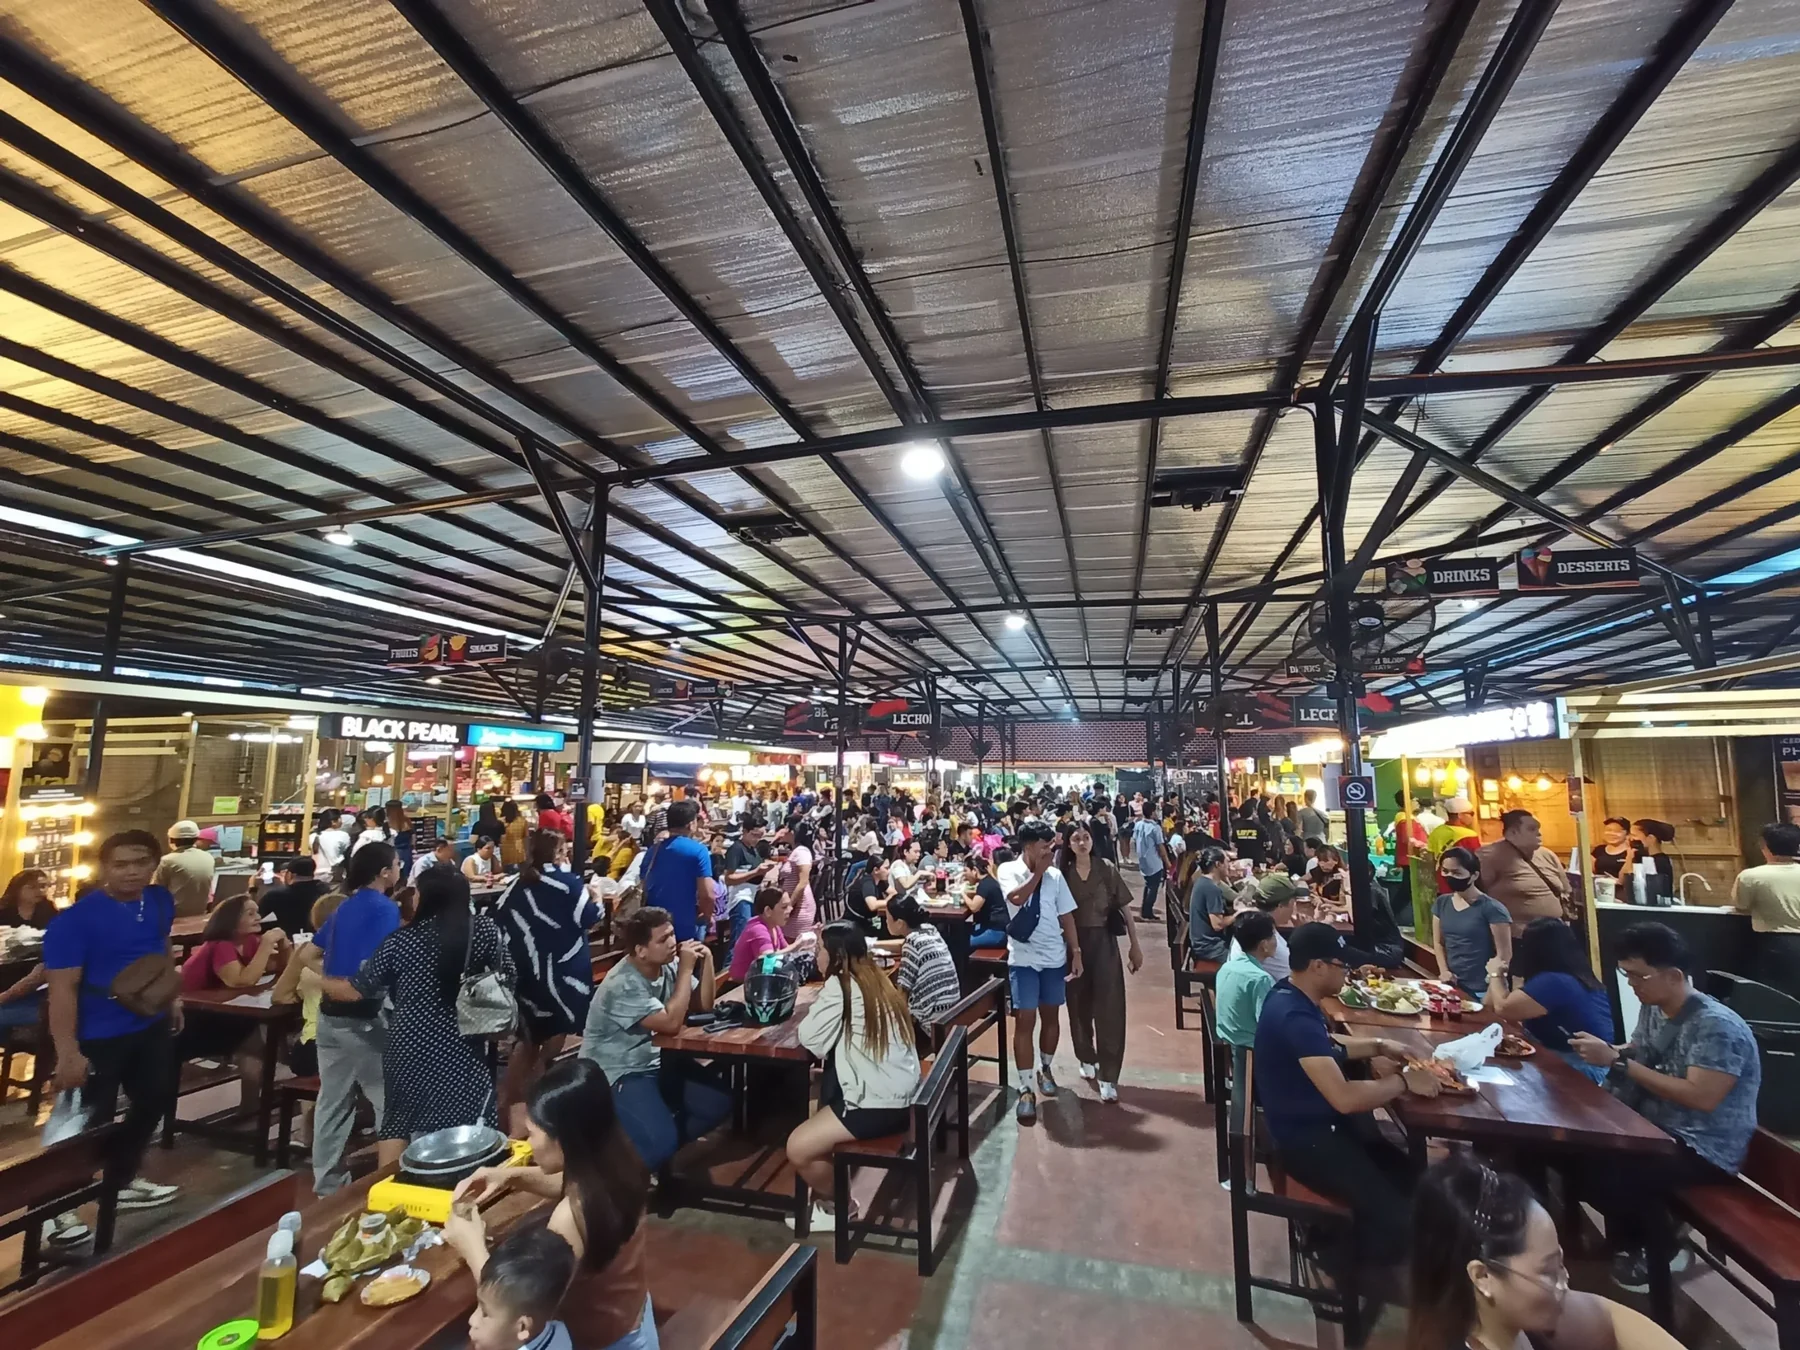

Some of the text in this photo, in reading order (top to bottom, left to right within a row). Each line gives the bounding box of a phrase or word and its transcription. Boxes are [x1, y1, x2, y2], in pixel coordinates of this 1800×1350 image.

[1557, 559, 1631, 575] DESSERTS
[1433, 568, 1491, 584] DRINKS
[390, 648, 419, 659] FRUITS
[469, 643, 499, 654] SNACKS
[341, 716, 406, 740] BLACK
[408, 721, 460, 743] PEARL
